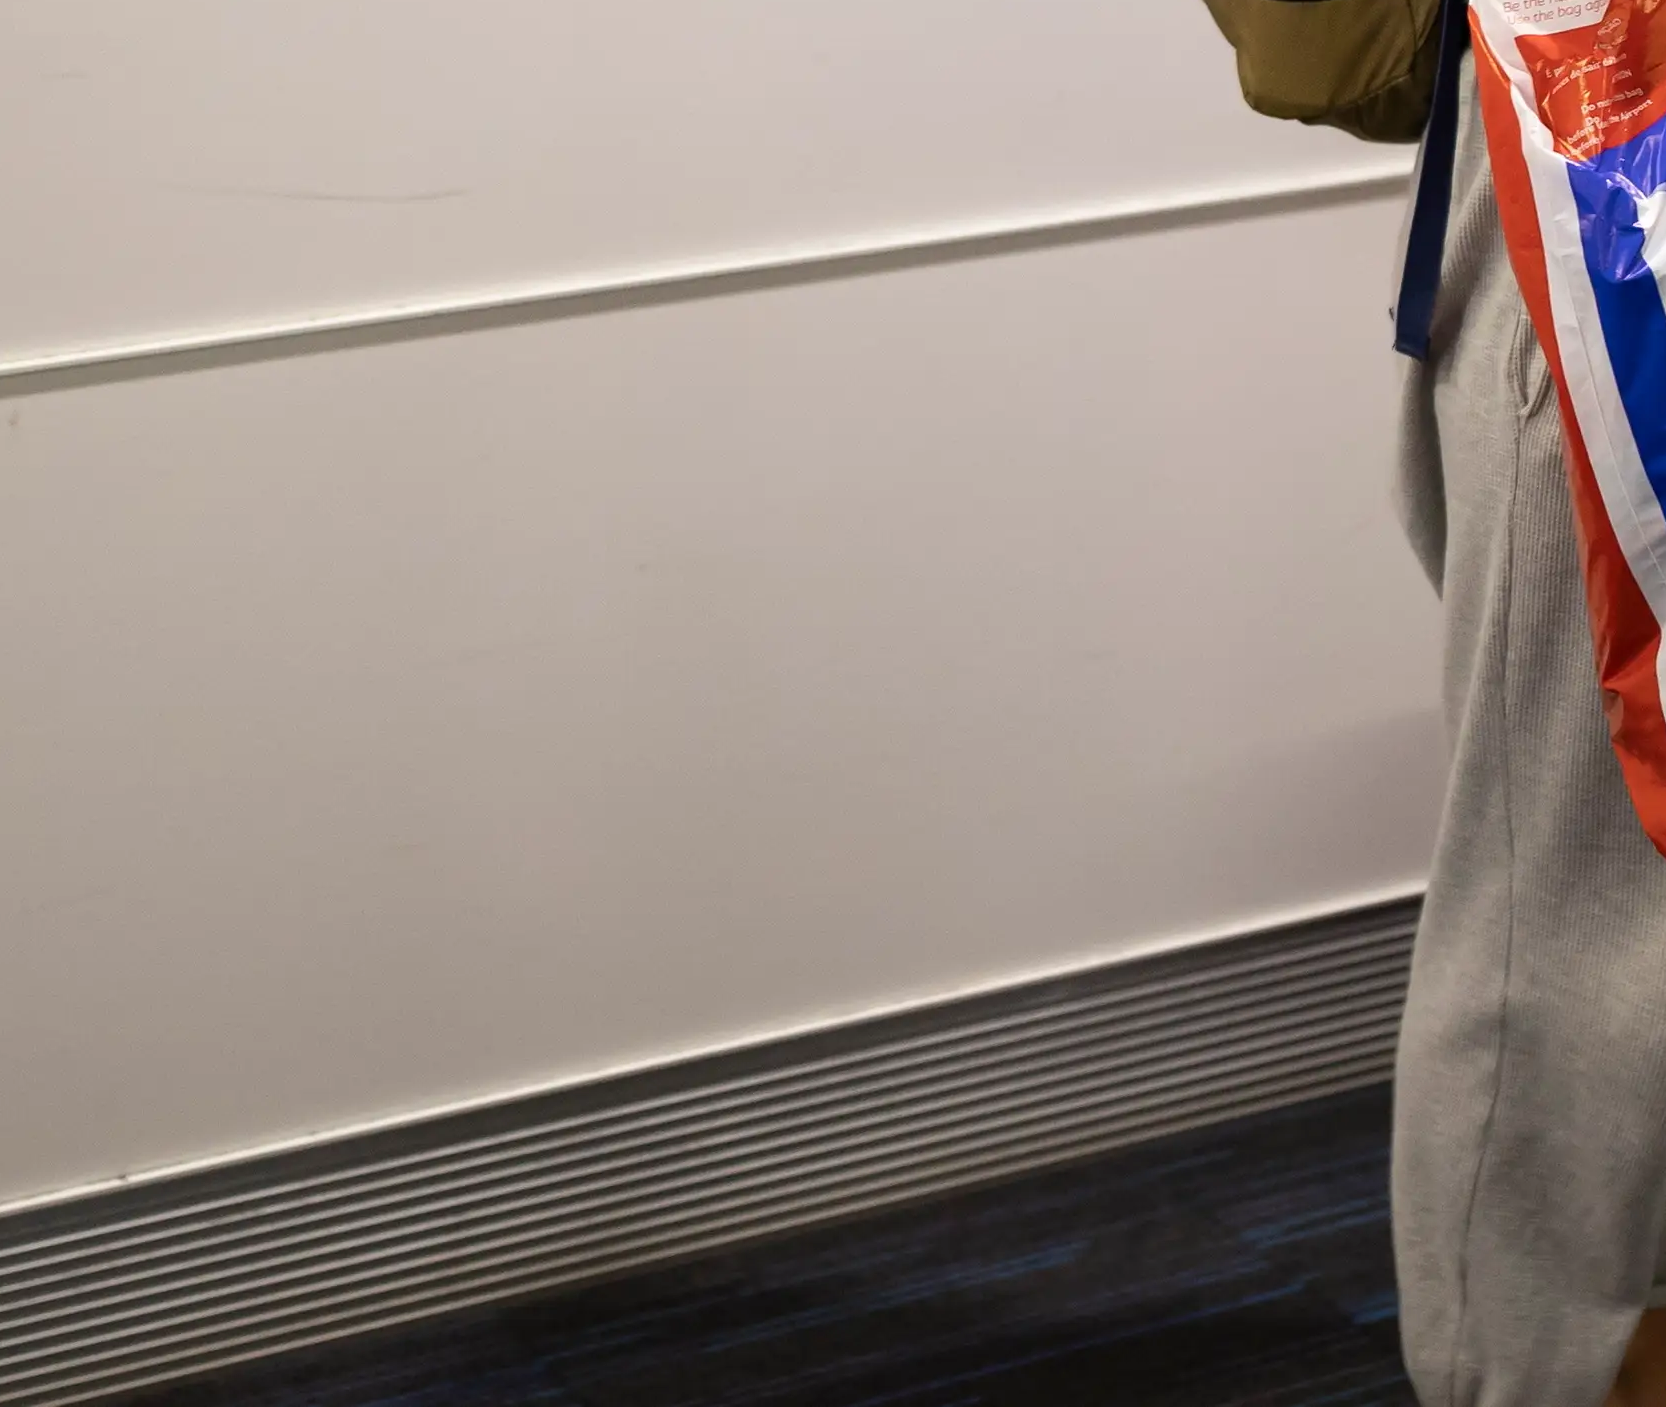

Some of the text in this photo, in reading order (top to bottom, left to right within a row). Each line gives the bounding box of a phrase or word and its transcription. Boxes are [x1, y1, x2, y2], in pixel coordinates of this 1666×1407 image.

[1503, 1, 1520, 13] Be
[1507, 15, 1531, 25] Use
[1533, 9, 1554, 23] the
[1557, 4, 1582, 18] bag
[1625, 87, 1644, 99] bag
[1620, 99, 1654, 122] Airport
